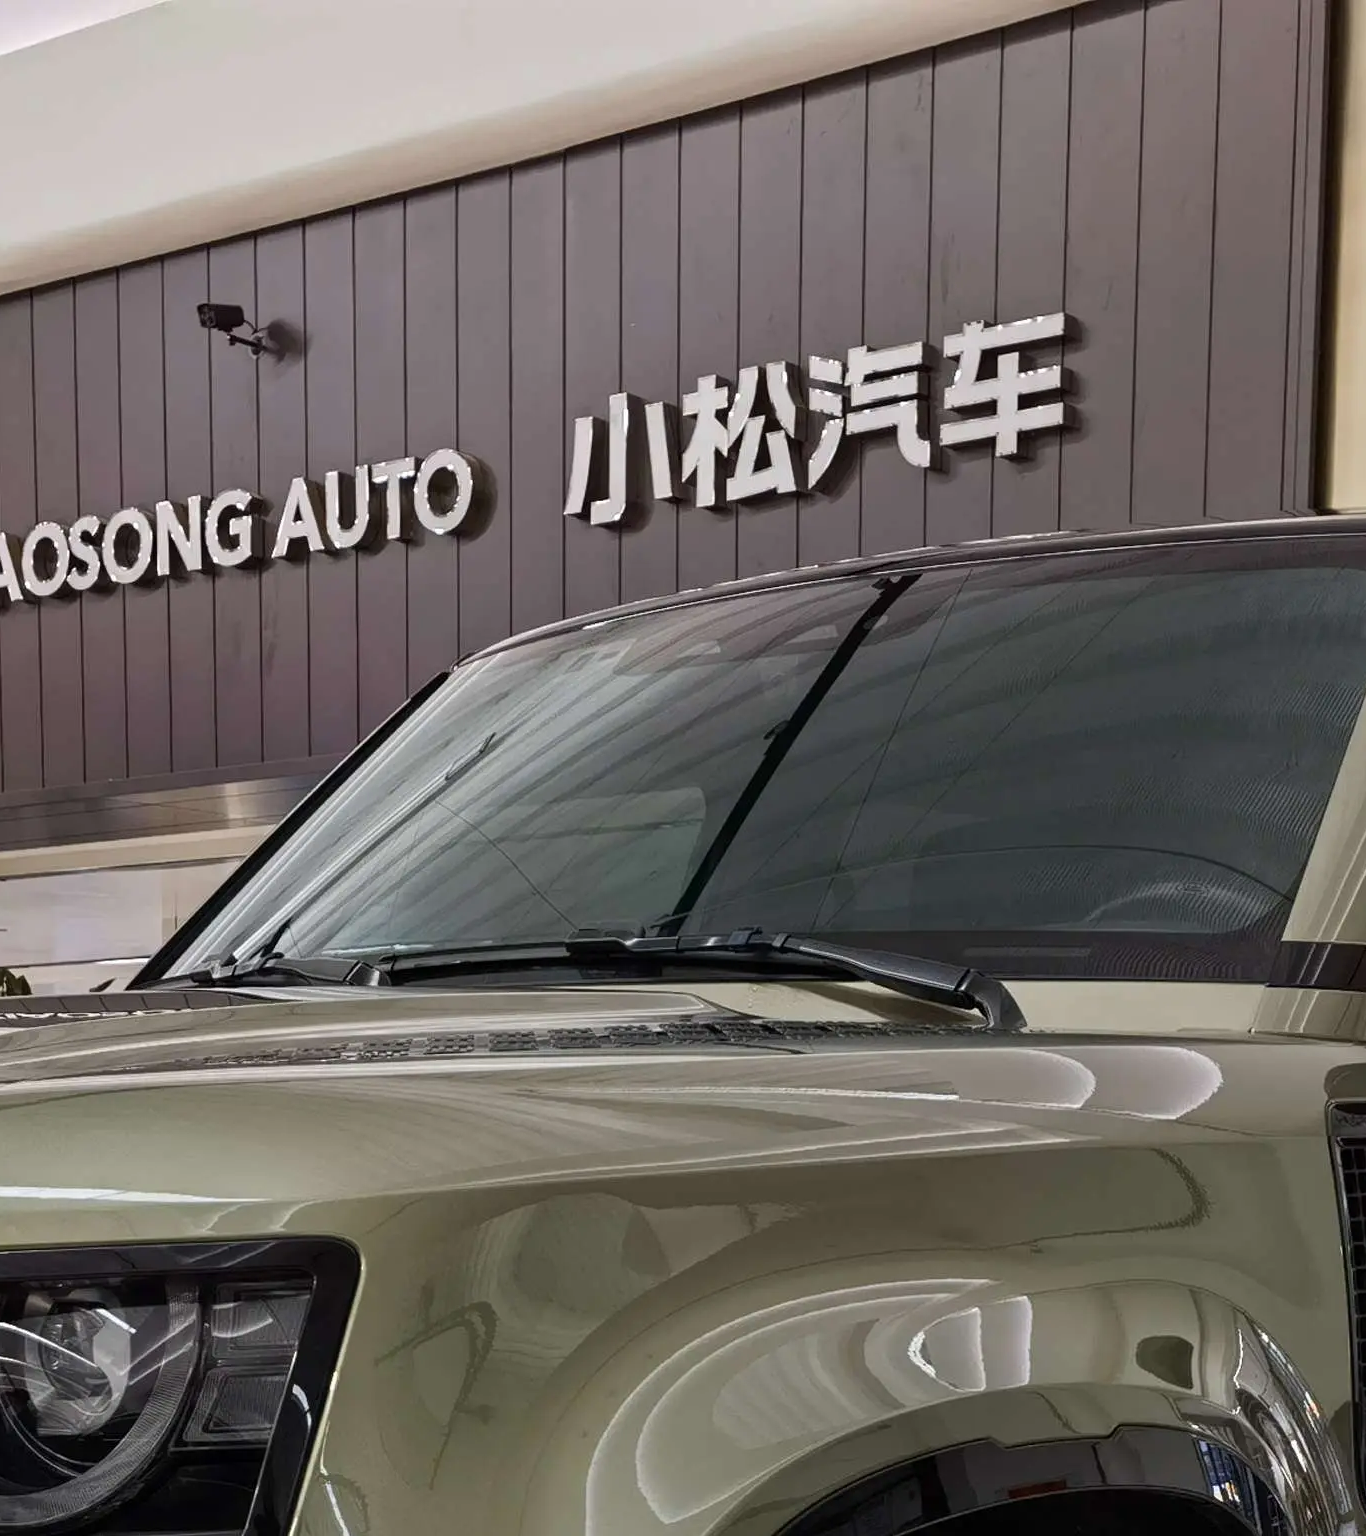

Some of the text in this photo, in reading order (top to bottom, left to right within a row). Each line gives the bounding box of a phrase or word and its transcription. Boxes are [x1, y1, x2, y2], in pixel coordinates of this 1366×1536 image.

[272, 446, 478, 562] AUTO
[564, 311, 1070, 530] 小松汽车
